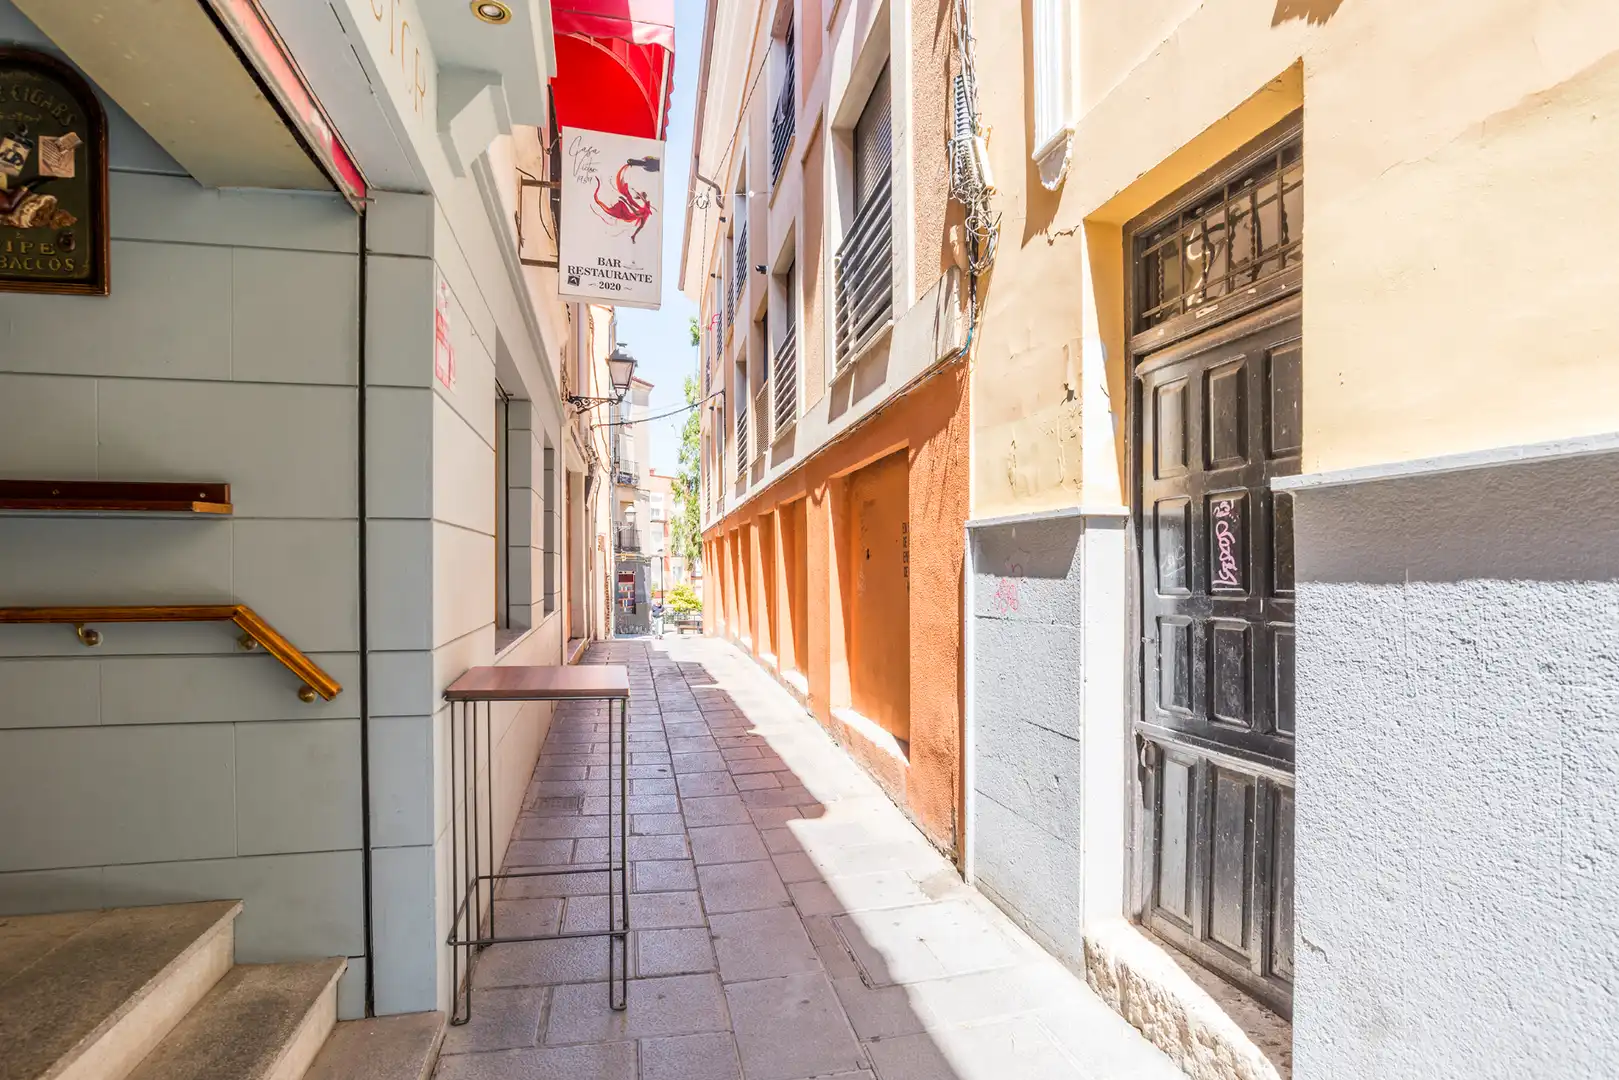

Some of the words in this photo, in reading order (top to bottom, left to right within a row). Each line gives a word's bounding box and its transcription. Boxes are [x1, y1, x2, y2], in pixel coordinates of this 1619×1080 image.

[597, 256, 622, 269] BAR
[567, 264, 653, 284] RESTAURANTE
[598, 281, 622, 292] 2020
